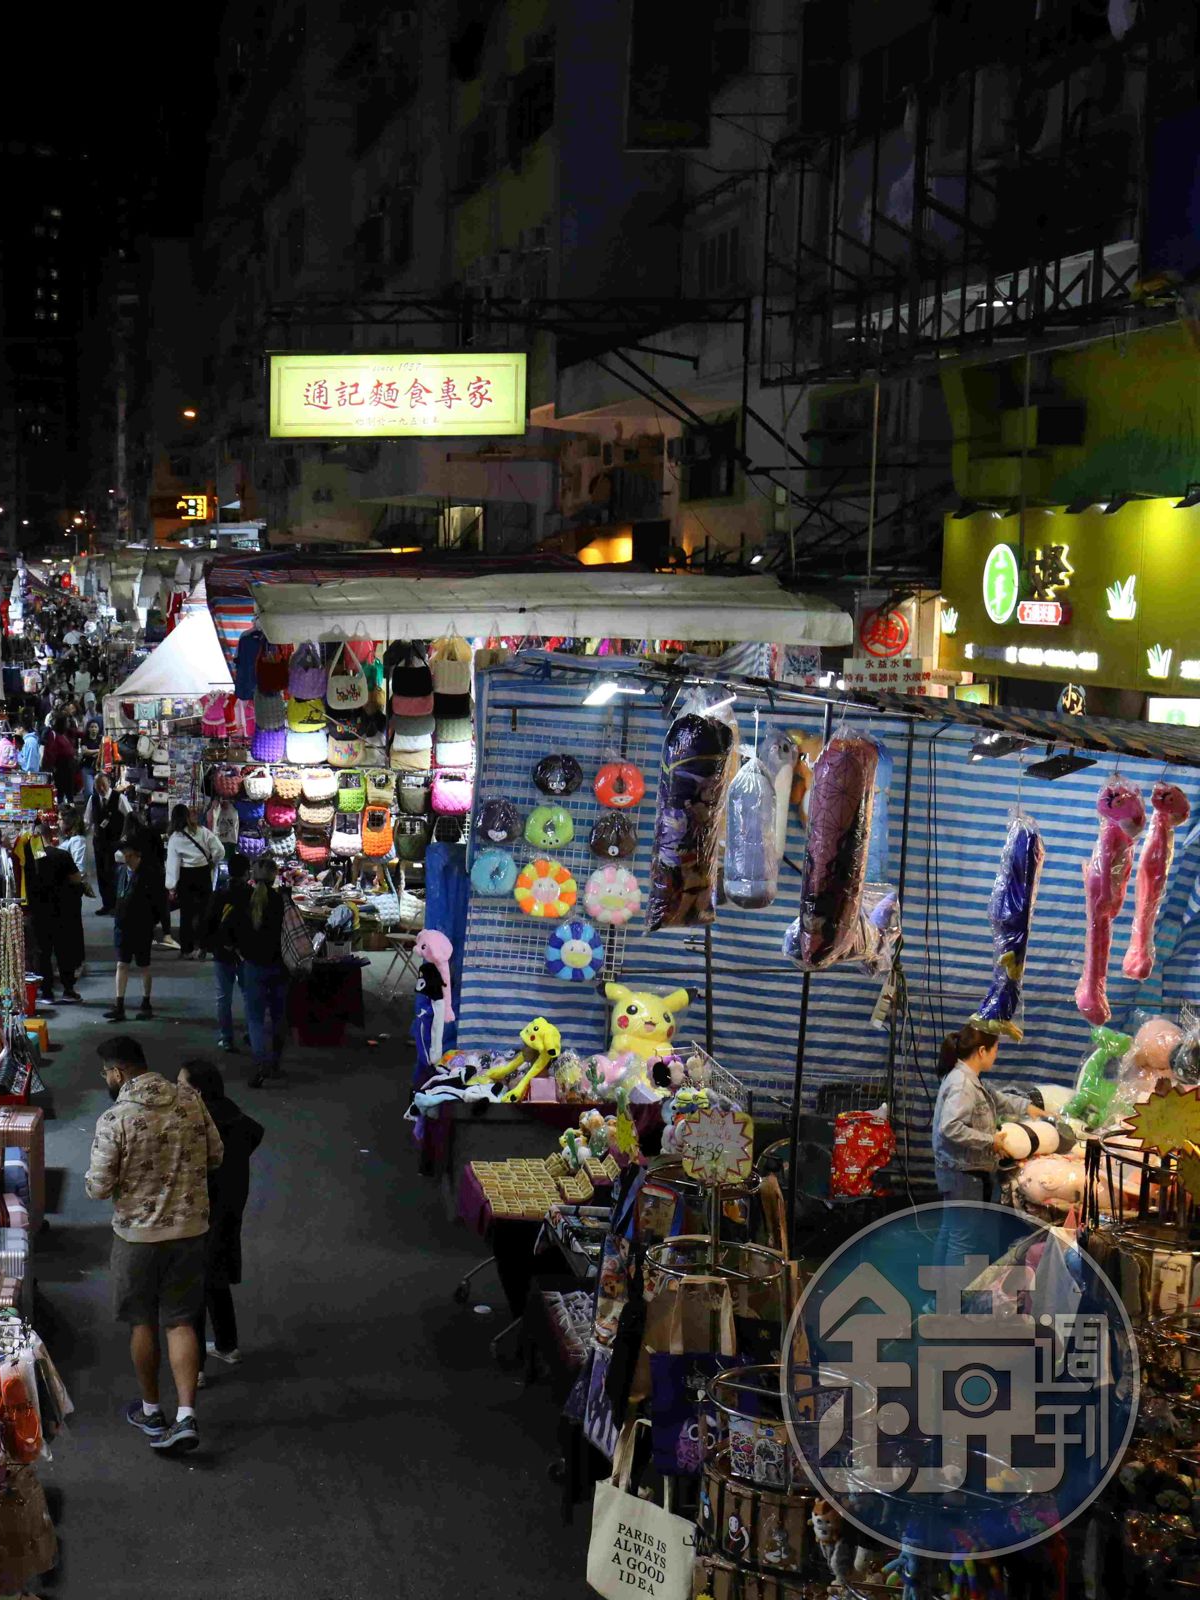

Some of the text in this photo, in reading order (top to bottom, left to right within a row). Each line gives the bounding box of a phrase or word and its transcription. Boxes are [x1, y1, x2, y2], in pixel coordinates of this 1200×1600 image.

[303, 375, 493, 410] 通記麵食專家
[613, 1537, 667, 1569] ALWAYS
[617, 1522, 667, 1554] PARIS IS
[611, 1552, 665, 1584] A GOOD
[619, 1569, 655, 1596] IDEA
